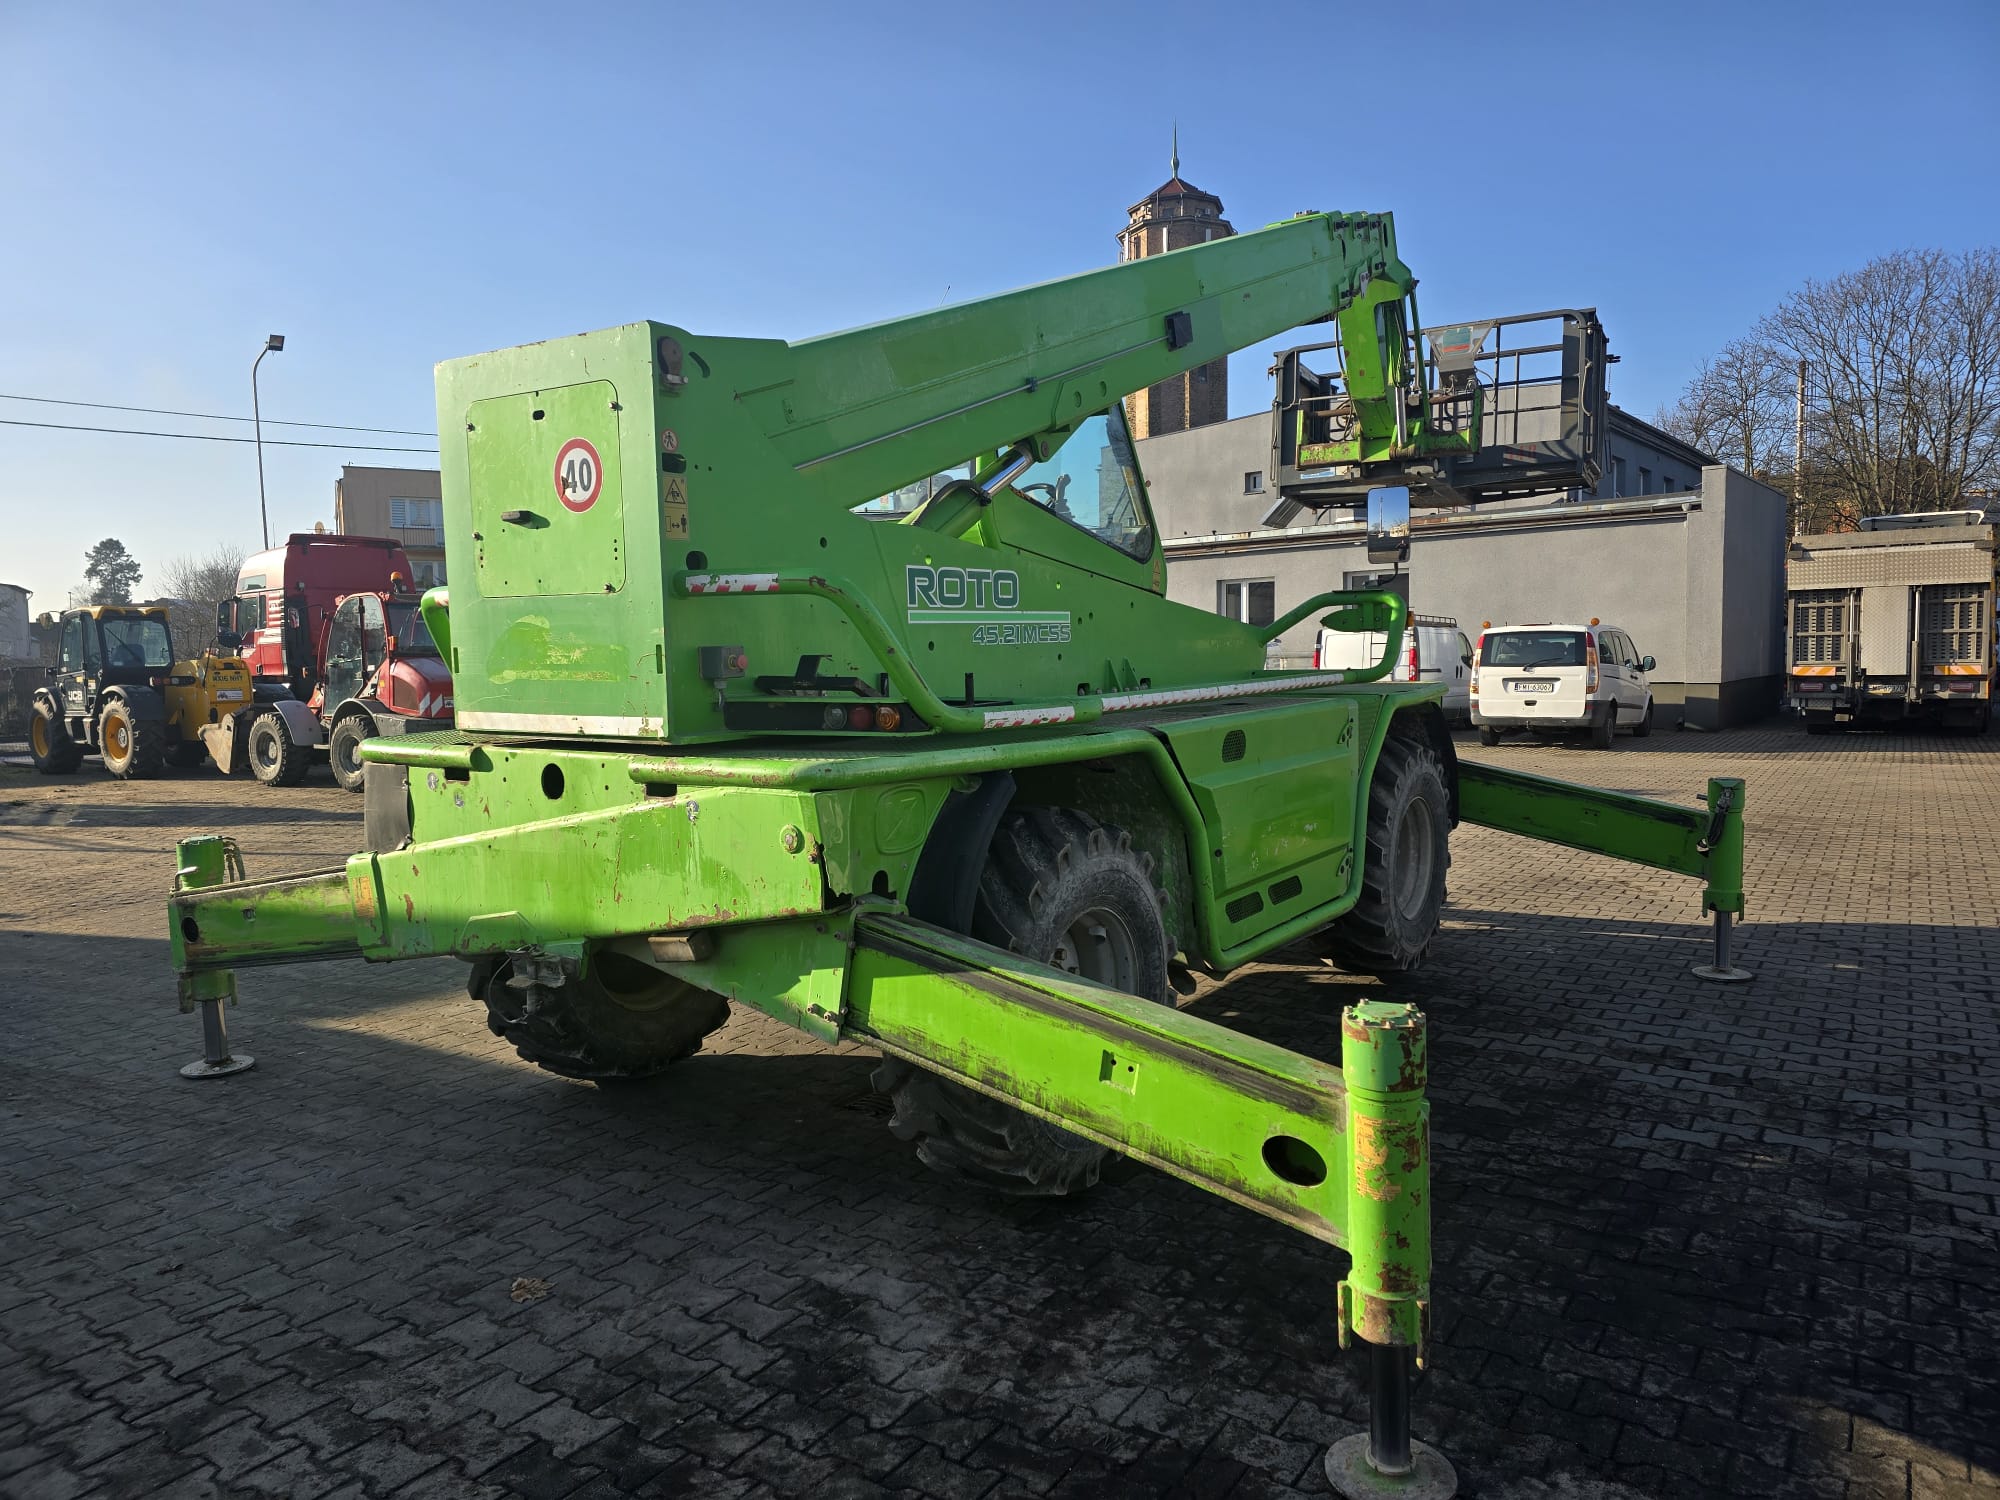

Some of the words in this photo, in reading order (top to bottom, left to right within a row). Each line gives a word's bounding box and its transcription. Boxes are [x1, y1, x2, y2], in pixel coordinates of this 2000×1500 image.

[565, 458, 592, 493] 40
[906, 565, 1019, 608] ROTO
[68, 690, 83, 701] JCB
